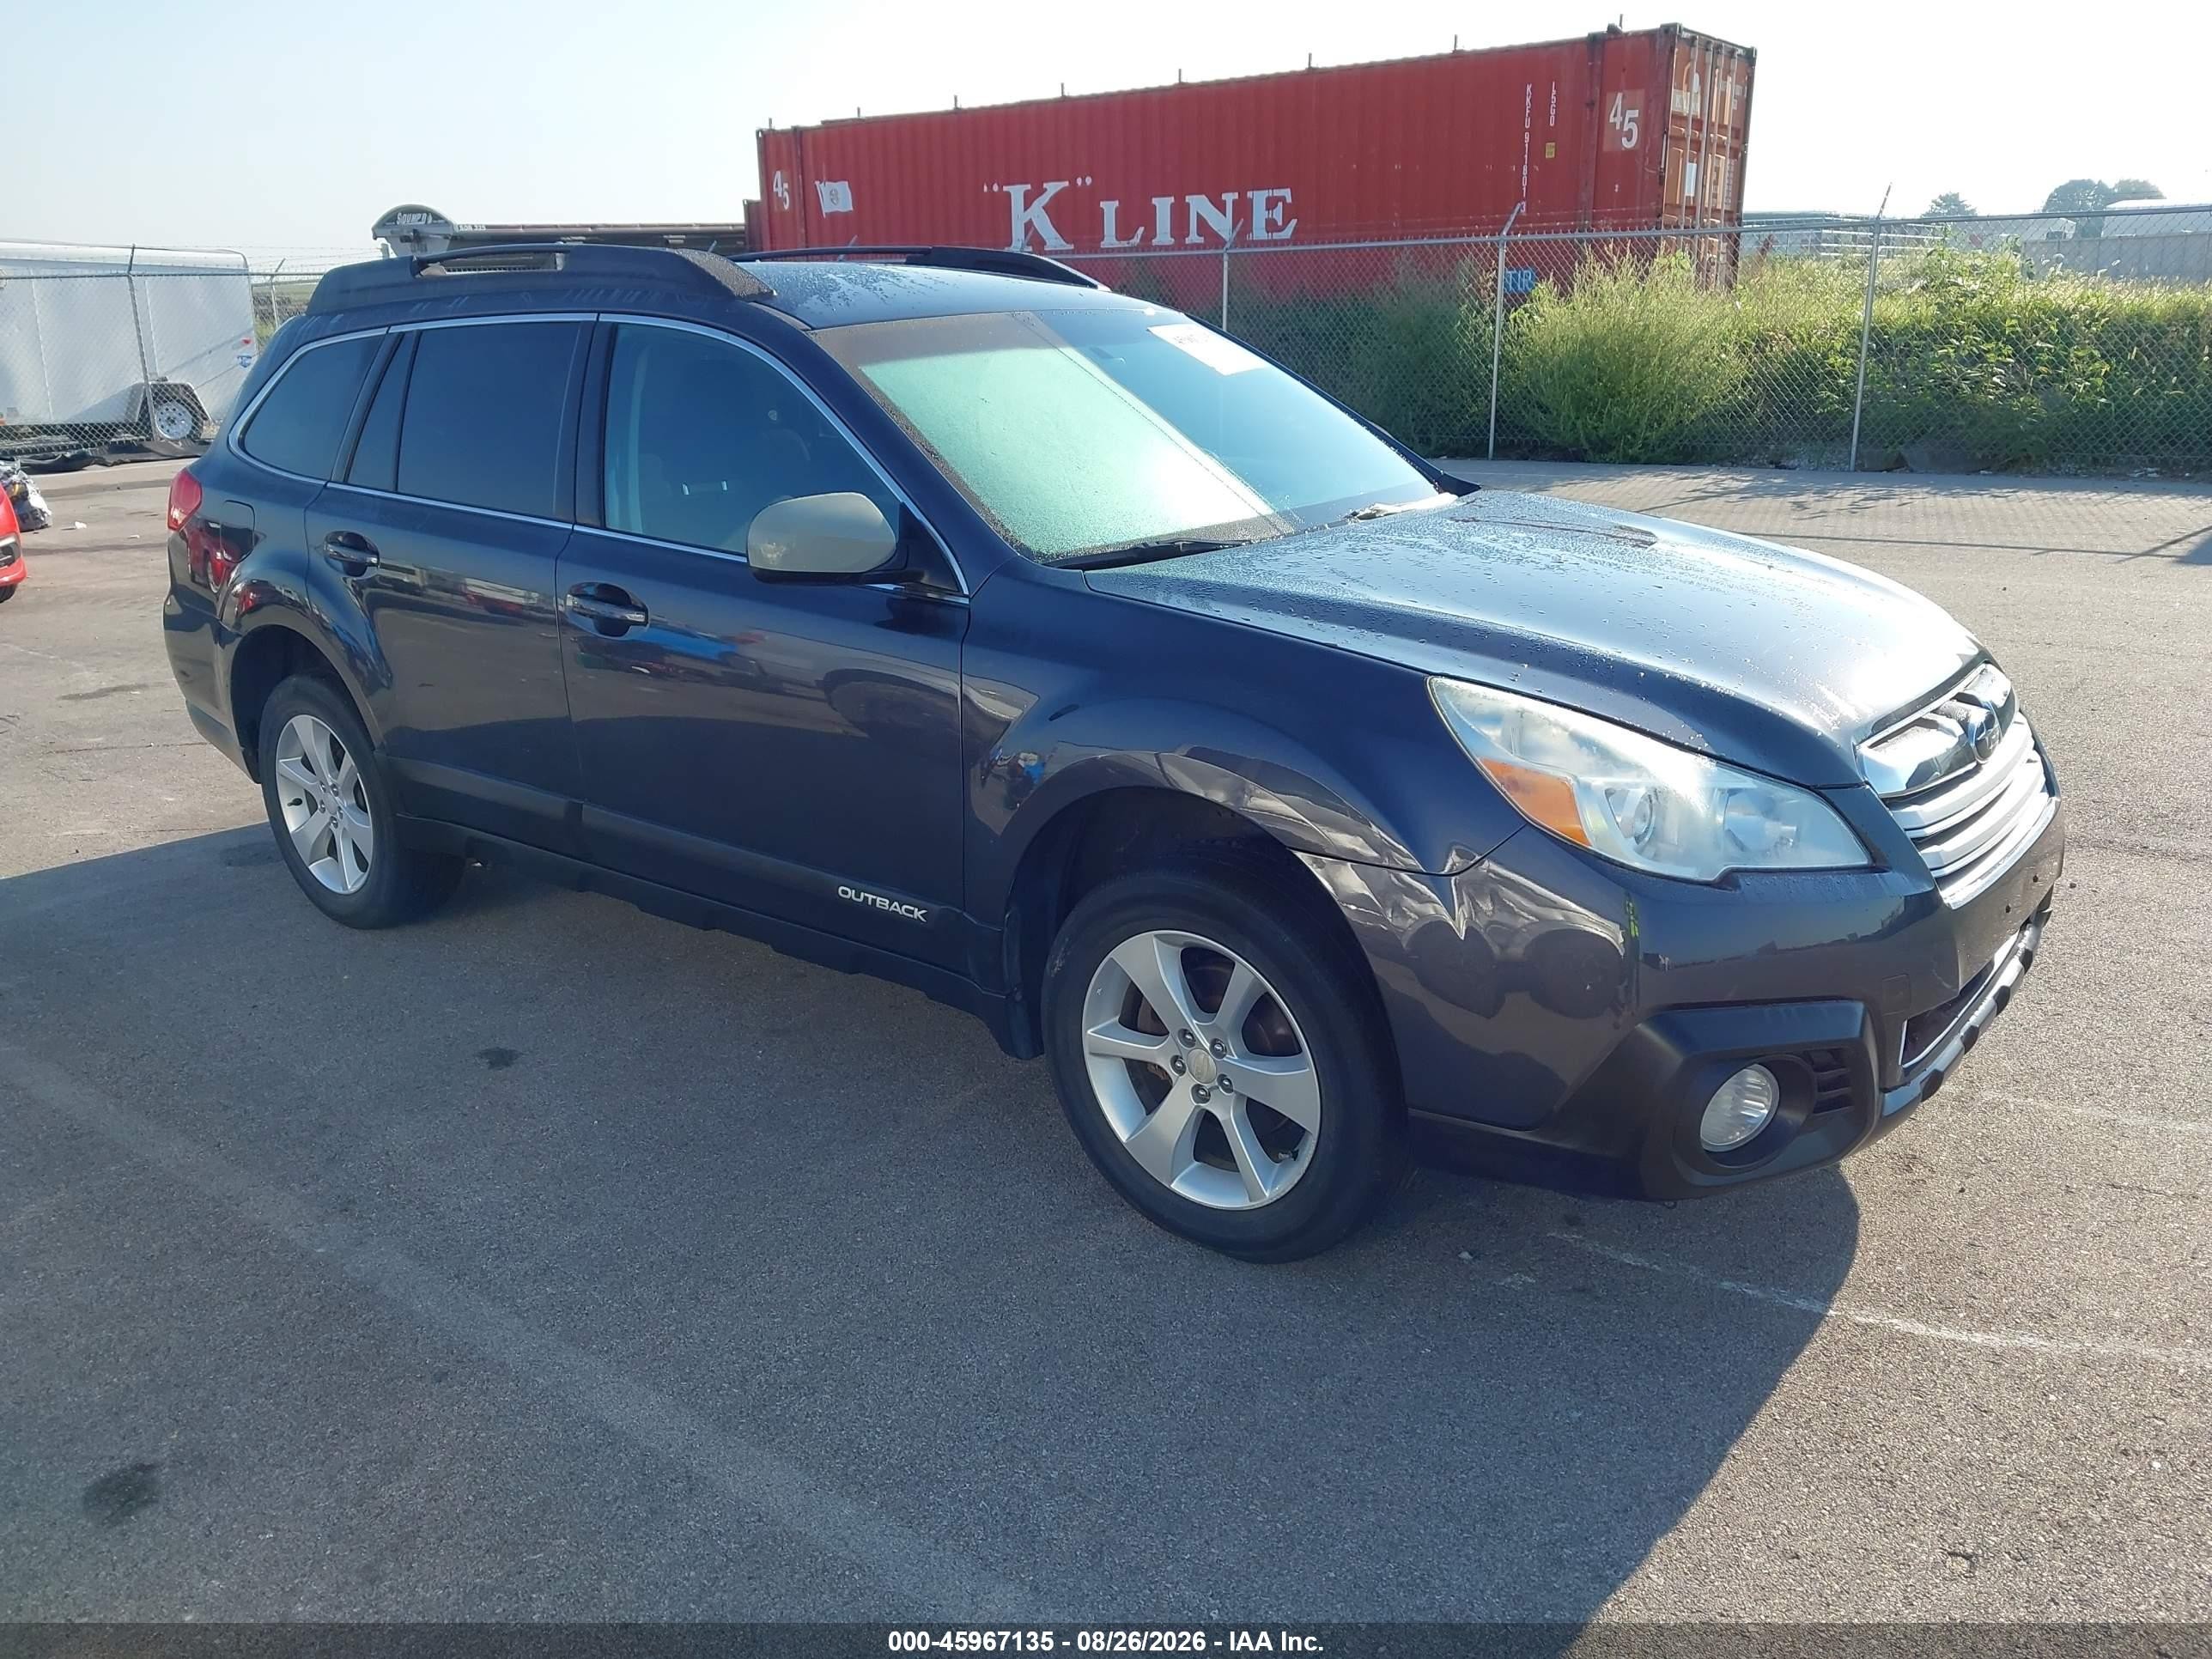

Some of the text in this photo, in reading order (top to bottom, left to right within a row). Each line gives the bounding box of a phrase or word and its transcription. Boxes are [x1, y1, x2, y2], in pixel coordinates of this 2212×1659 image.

[1609, 92, 1639, 149] 45
[773, 170, 790, 210] 45
[1100, 188, 1298, 248] LINE
[1506, 270, 1535, 292] TIR
[837, 885, 928, 923] OUTBACK
